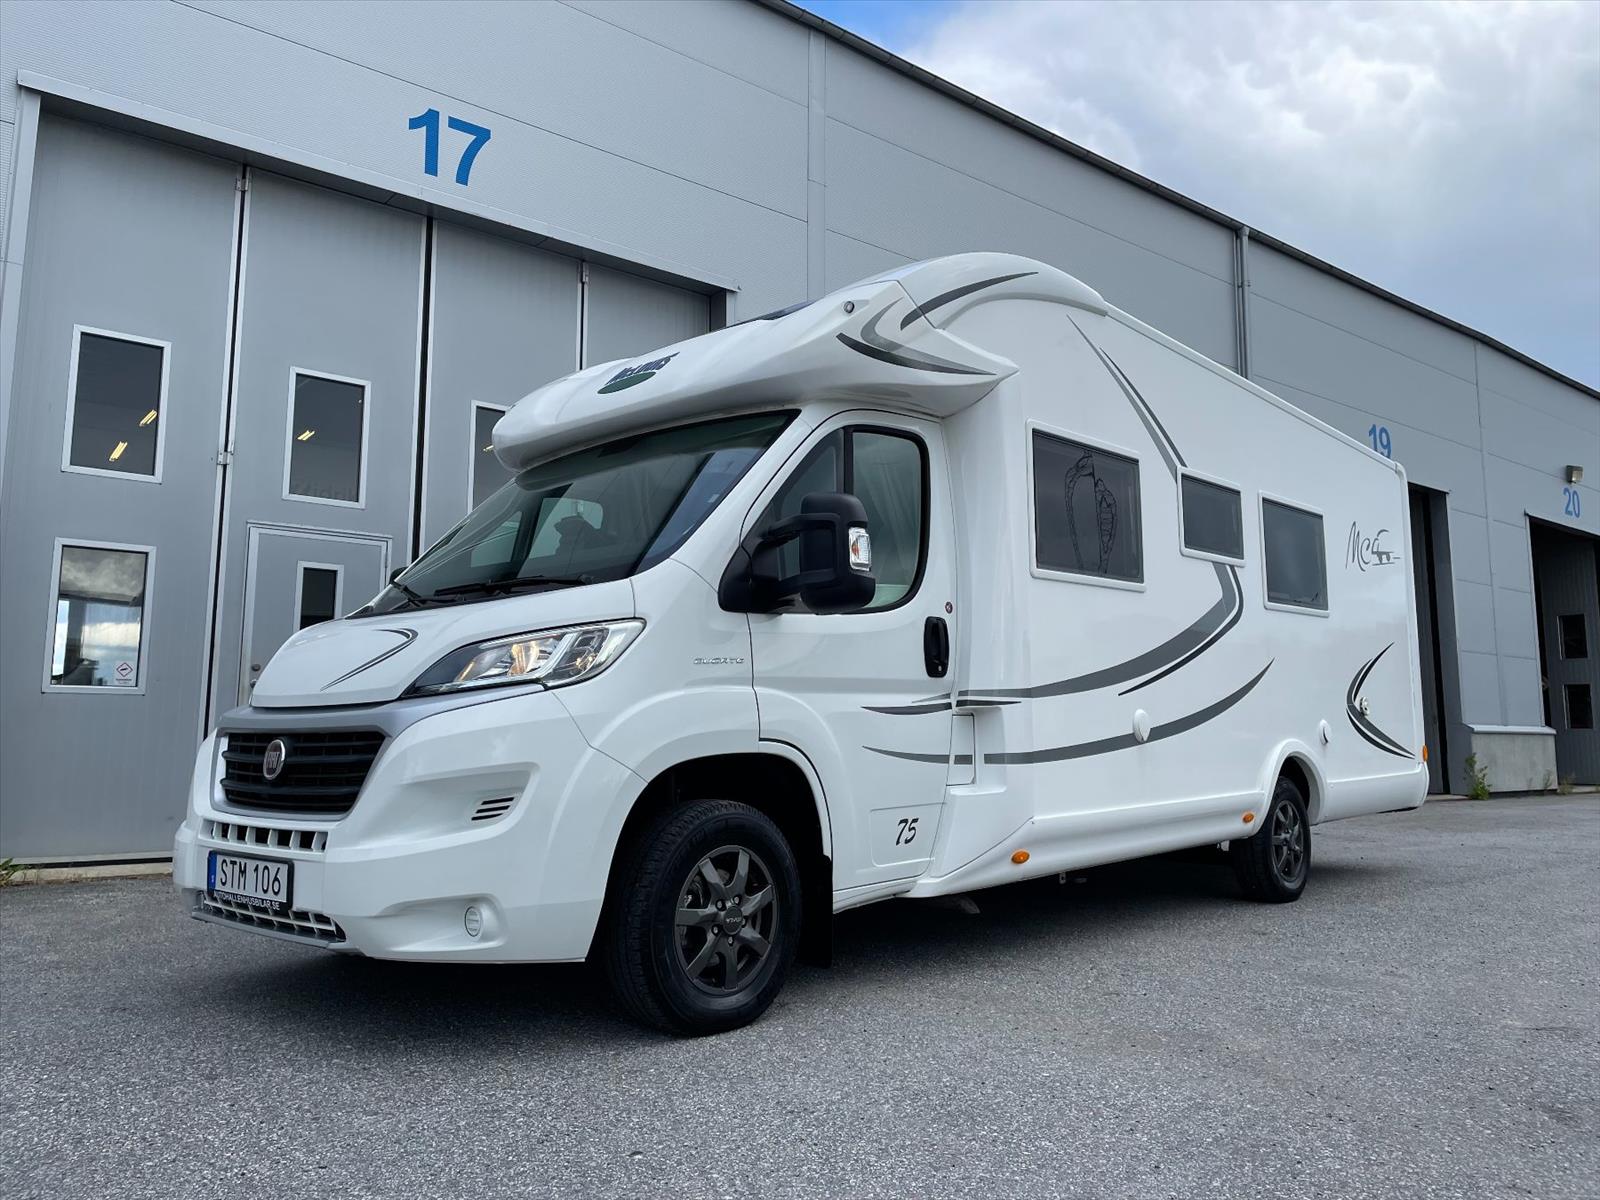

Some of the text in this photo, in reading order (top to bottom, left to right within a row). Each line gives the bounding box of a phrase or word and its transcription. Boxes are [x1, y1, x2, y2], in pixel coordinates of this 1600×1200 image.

[408, 107, 492, 187] 17
[1368, 423, 1392, 459] 19
[1563, 487, 1581, 519] 20
[895, 817, 920, 846] 75
[220, 858, 282, 896] STM 106
